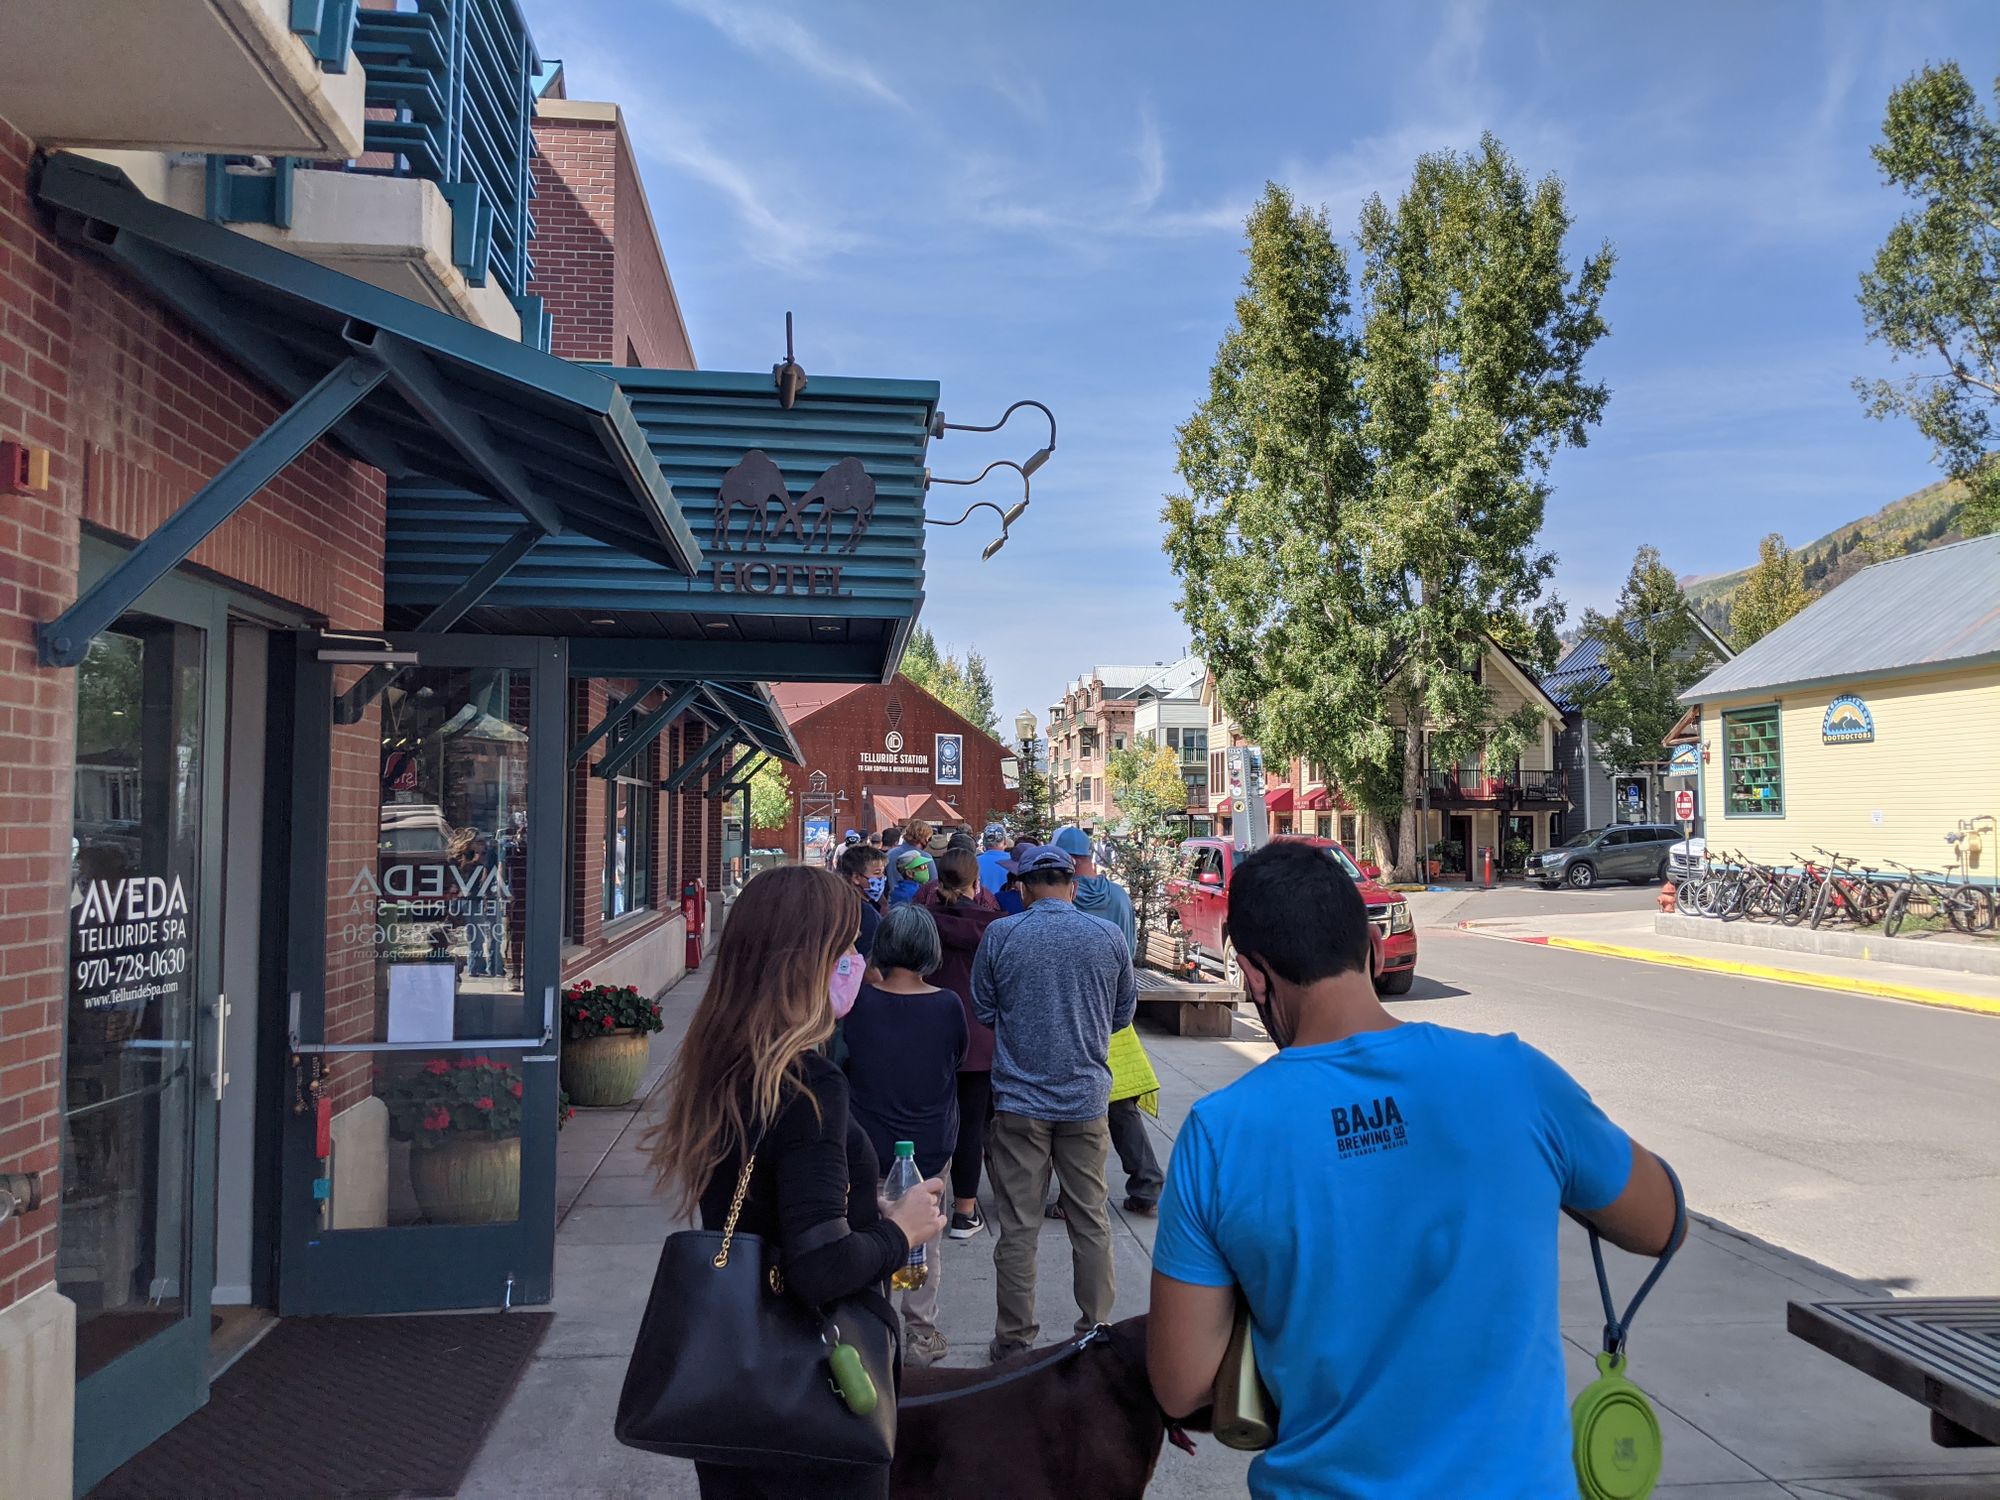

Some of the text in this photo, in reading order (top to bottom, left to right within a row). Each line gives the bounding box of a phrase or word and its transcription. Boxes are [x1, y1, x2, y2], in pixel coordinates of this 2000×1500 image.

[711, 561, 853, 598] HOTEL
[1823, 732, 1871, 742] BOOTDOCTORS
[860, 752, 928, 765] TELLURIDE STATION
[78, 873, 189, 926] AVEDA
[79, 918, 187, 953] TELLURIDE SPA
[77, 947, 186, 991] 970-728-0630
[84, 981, 179, 1009] www.TellurideSpa.com
[1331, 1096, 1404, 1137] BAJA
[1337, 1128, 1392, 1152] BREWING
